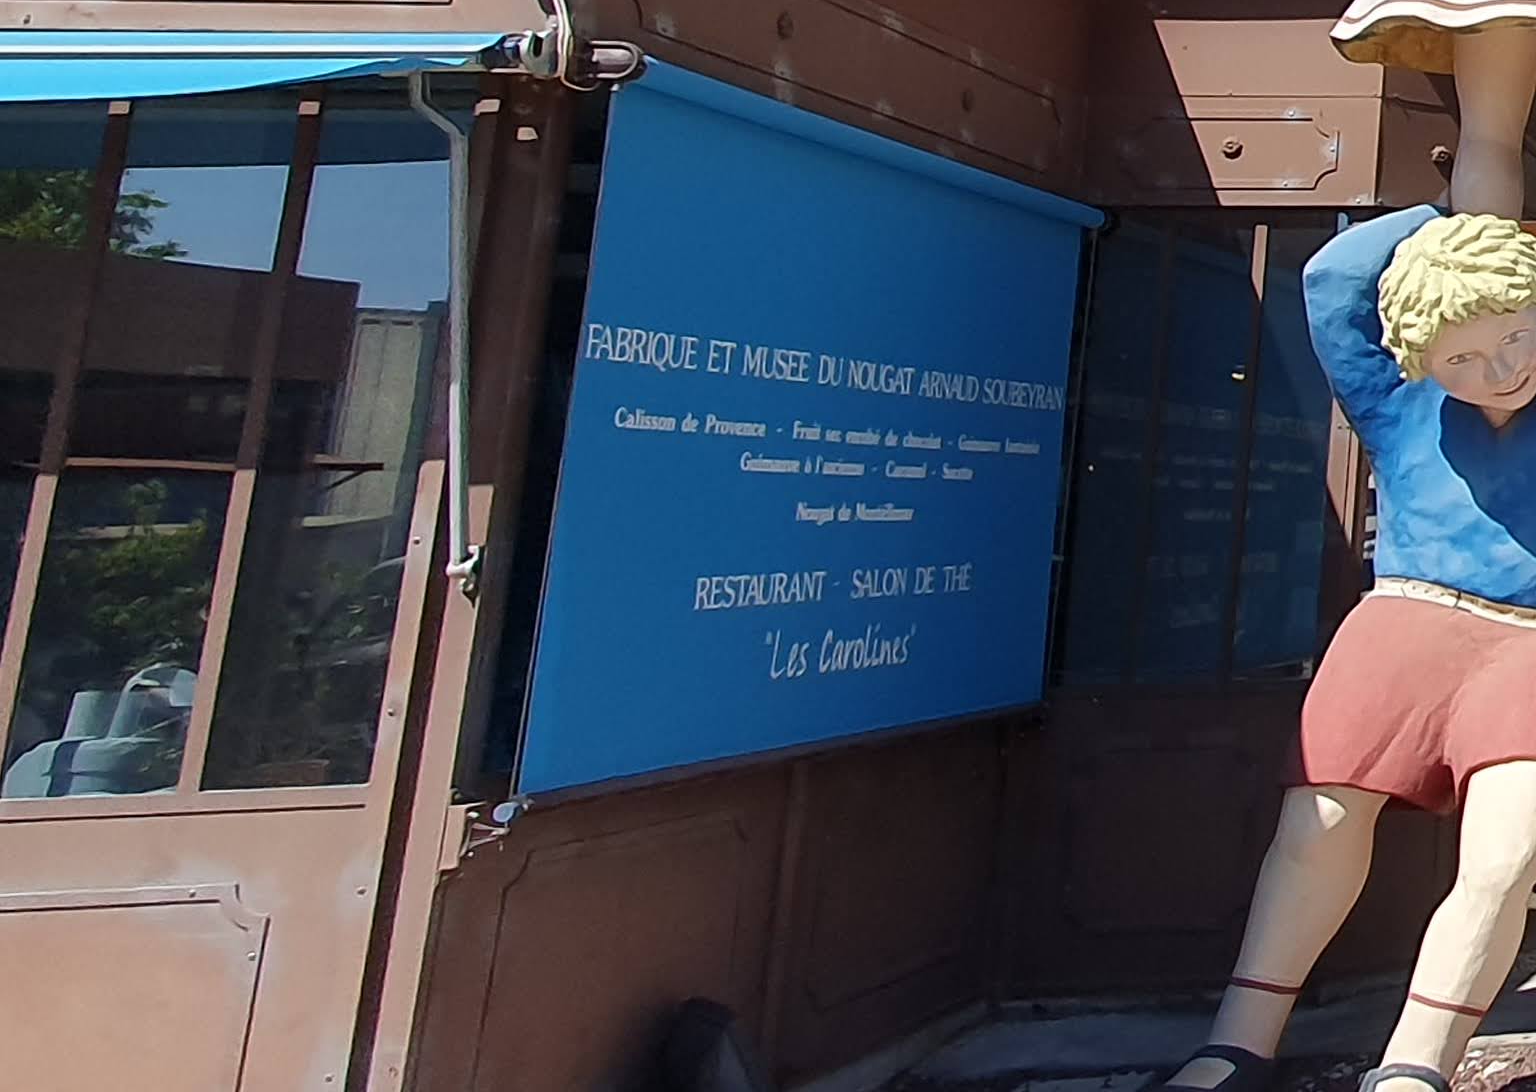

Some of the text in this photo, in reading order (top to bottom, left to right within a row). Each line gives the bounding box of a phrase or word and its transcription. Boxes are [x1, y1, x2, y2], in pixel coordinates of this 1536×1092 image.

[585, 323, 1065, 410] FABRIQUE ET MUSEE DU NOUGAT ARNAUD SOUBEYRAN
[614, 406, 676, 432] Calisson
[681, 412, 699, 433] de
[704, 413, 767, 438] Provence
[693, 571, 827, 610] RESTAURANT
[849, 567, 909, 599] SALON
[914, 565, 936, 595] DE
